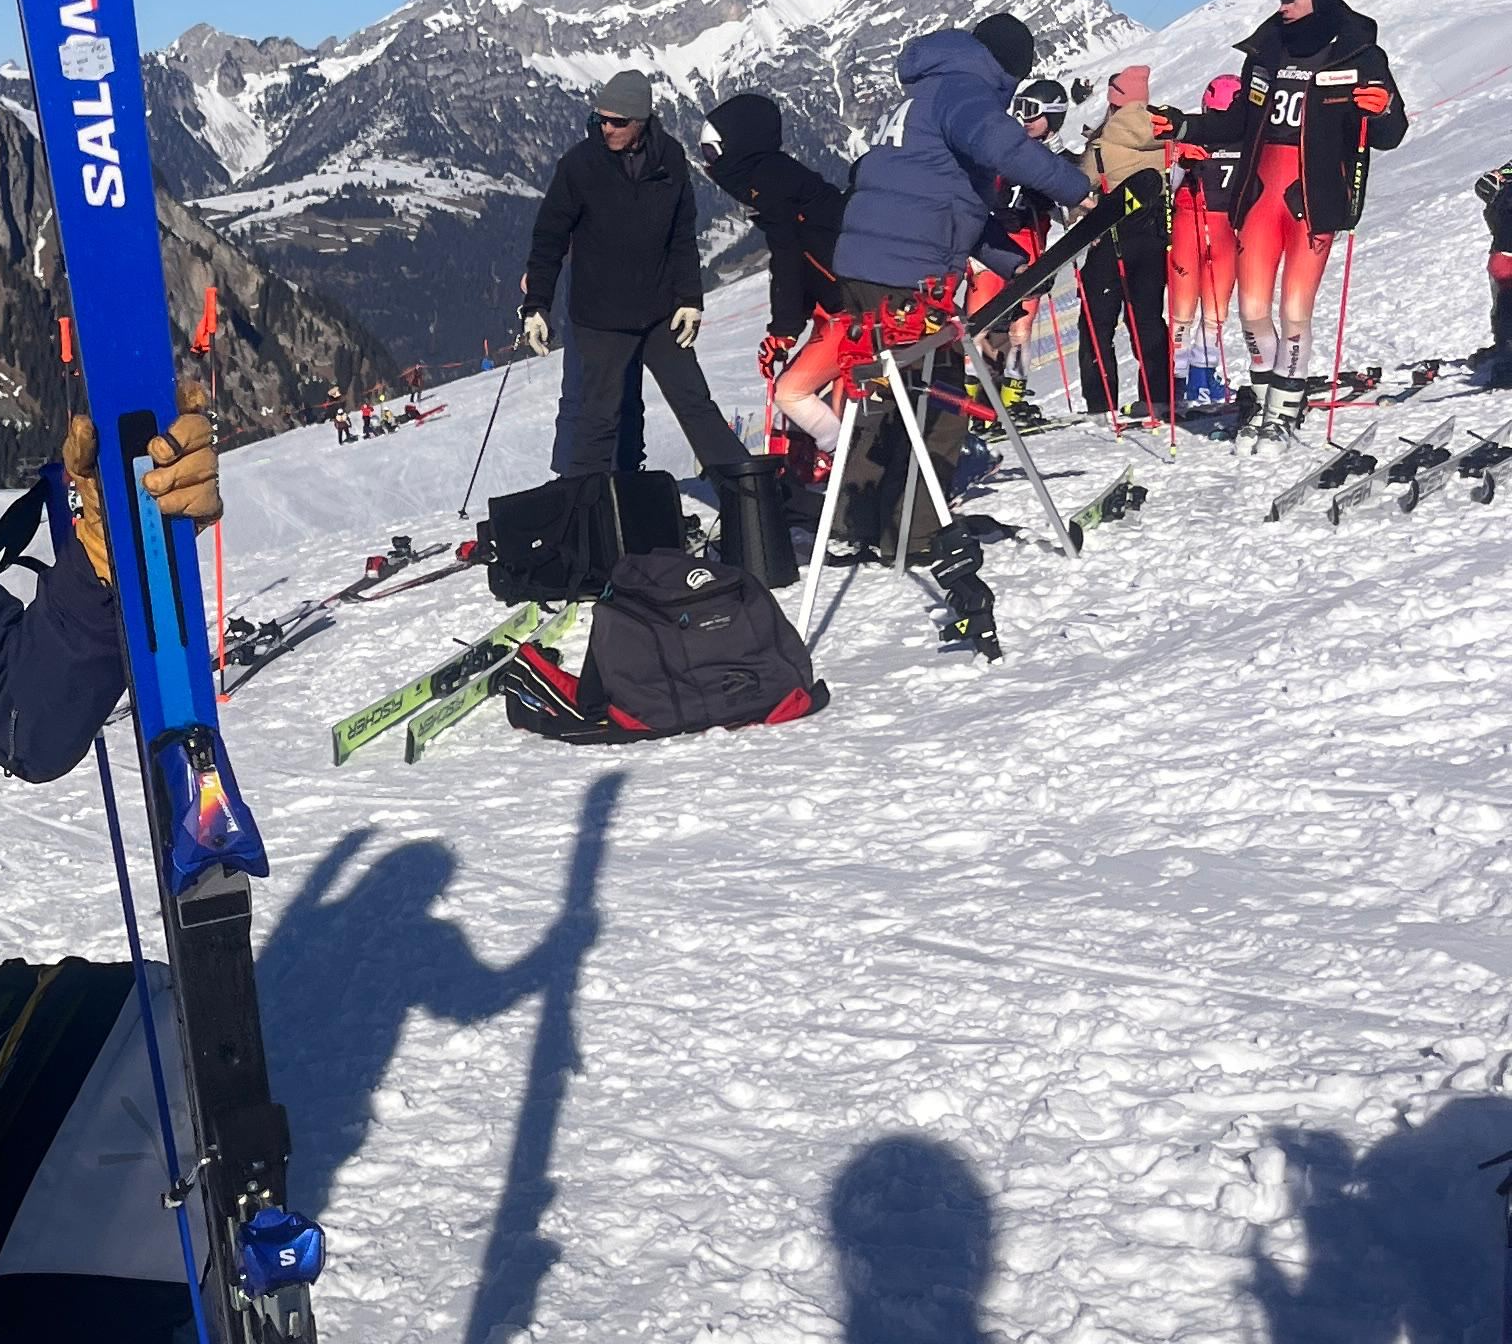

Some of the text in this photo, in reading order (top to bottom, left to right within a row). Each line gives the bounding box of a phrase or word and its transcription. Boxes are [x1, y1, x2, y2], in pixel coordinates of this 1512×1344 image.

[1270, 89, 1306, 127] 30
[1220, 165, 1234, 188] 7
[348, 693, 404, 740] FISCHER
